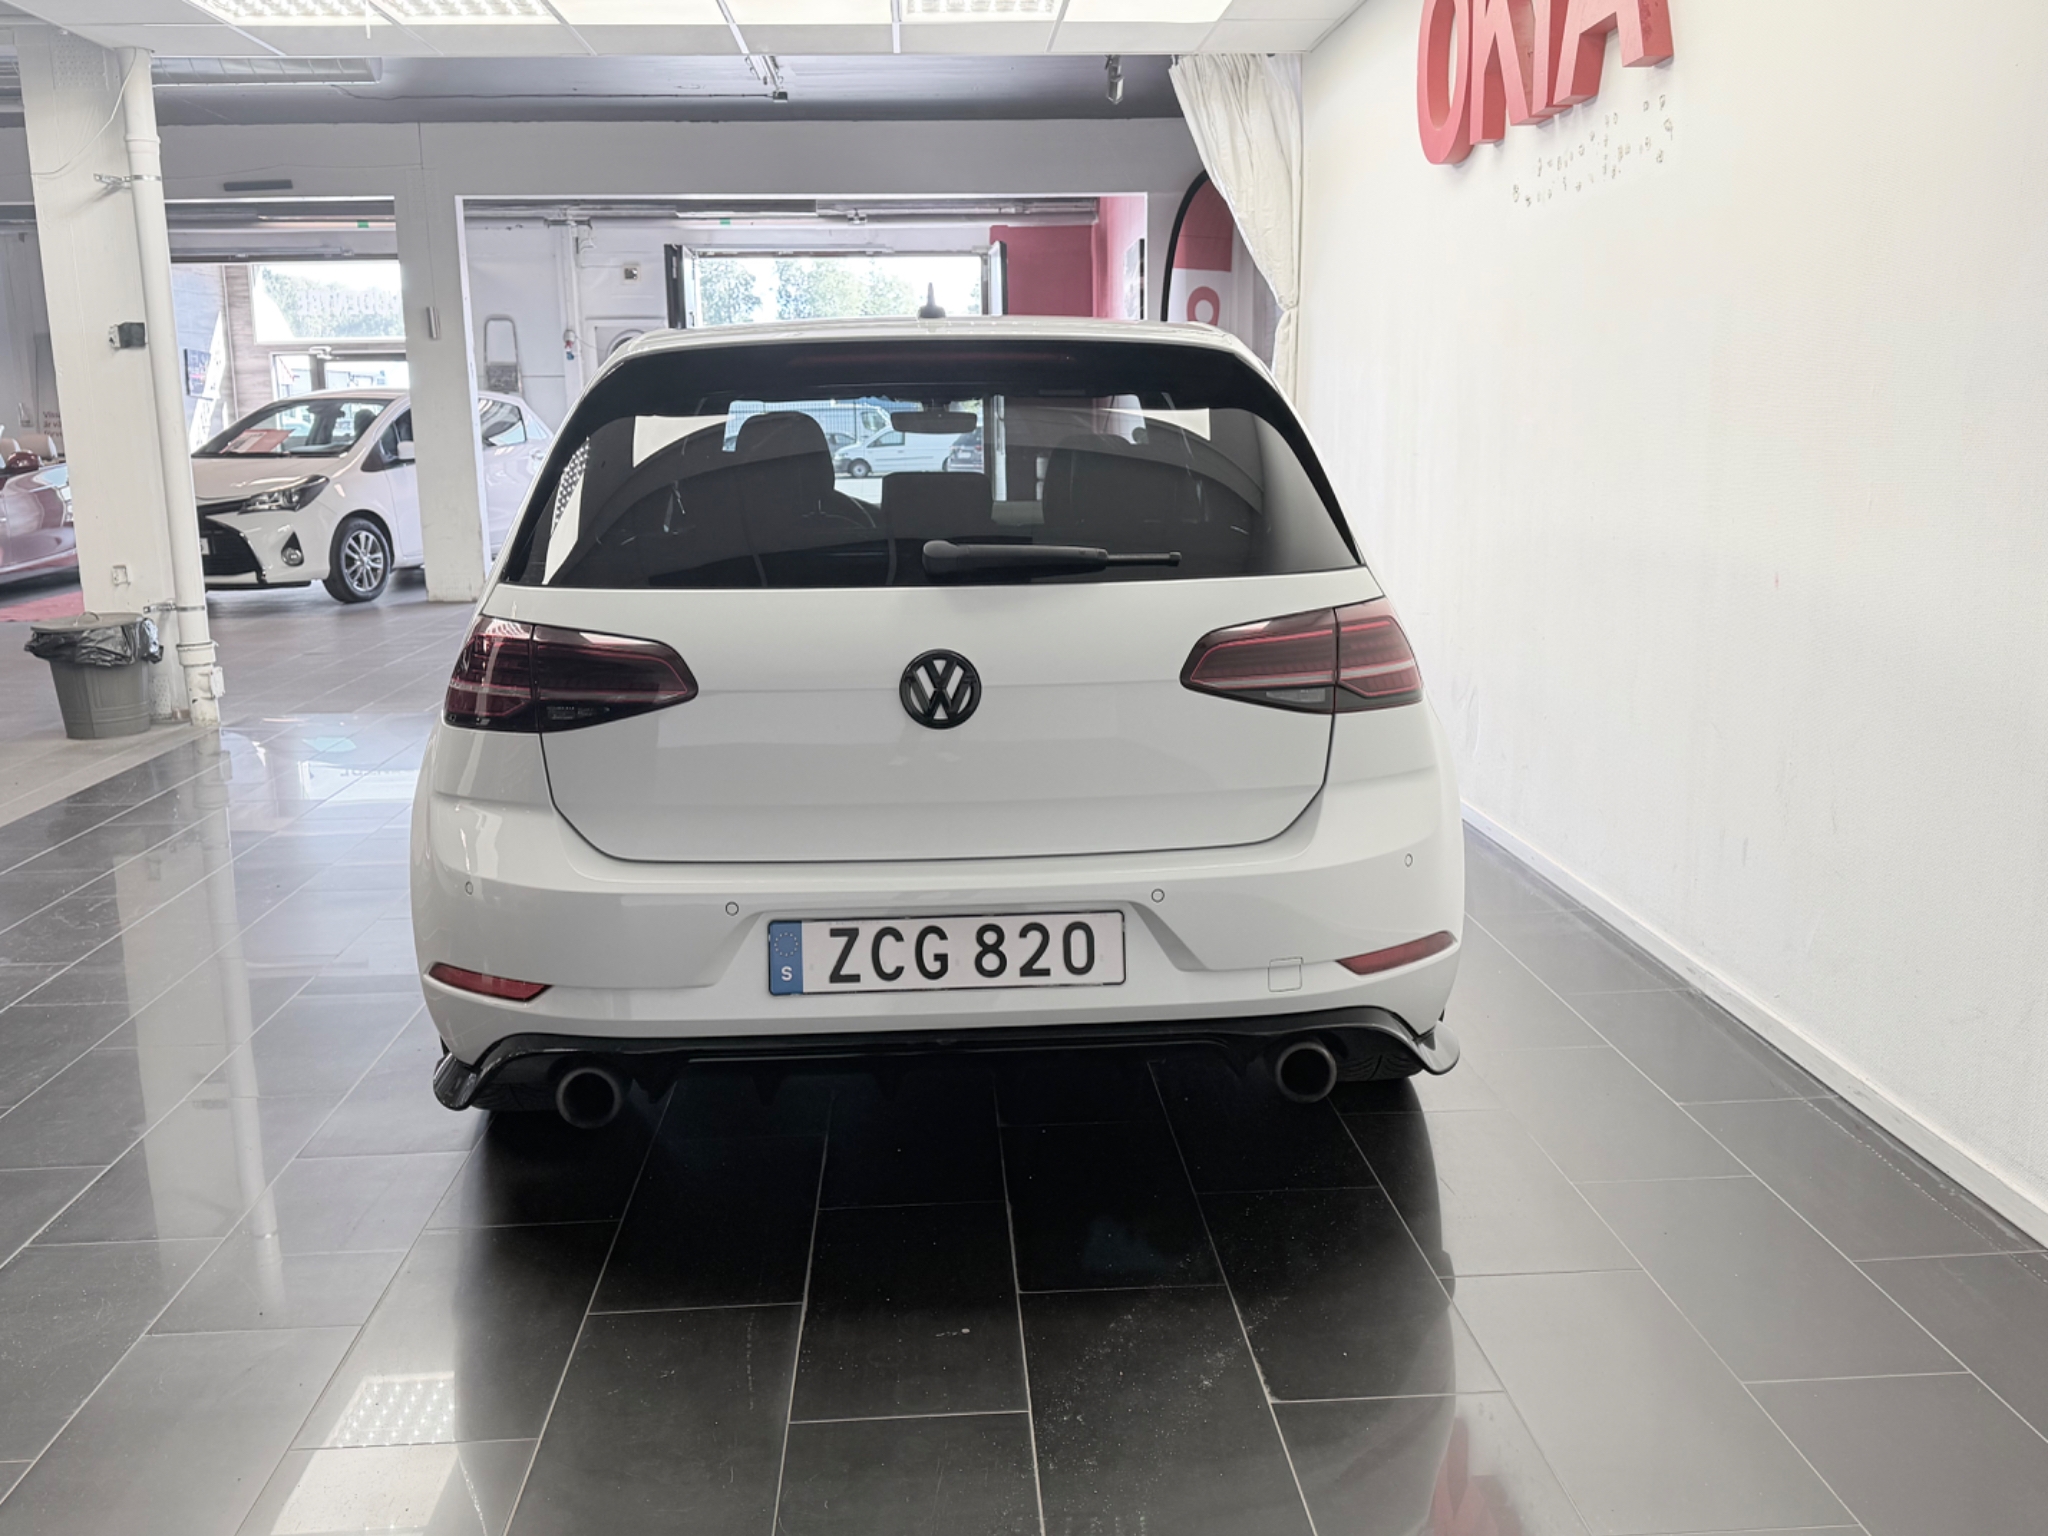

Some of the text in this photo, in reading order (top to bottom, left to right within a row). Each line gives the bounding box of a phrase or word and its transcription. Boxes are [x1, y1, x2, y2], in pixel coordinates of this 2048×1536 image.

[829, 921, 1095, 984] ZCG 820
[781, 965, 793, 981] S
